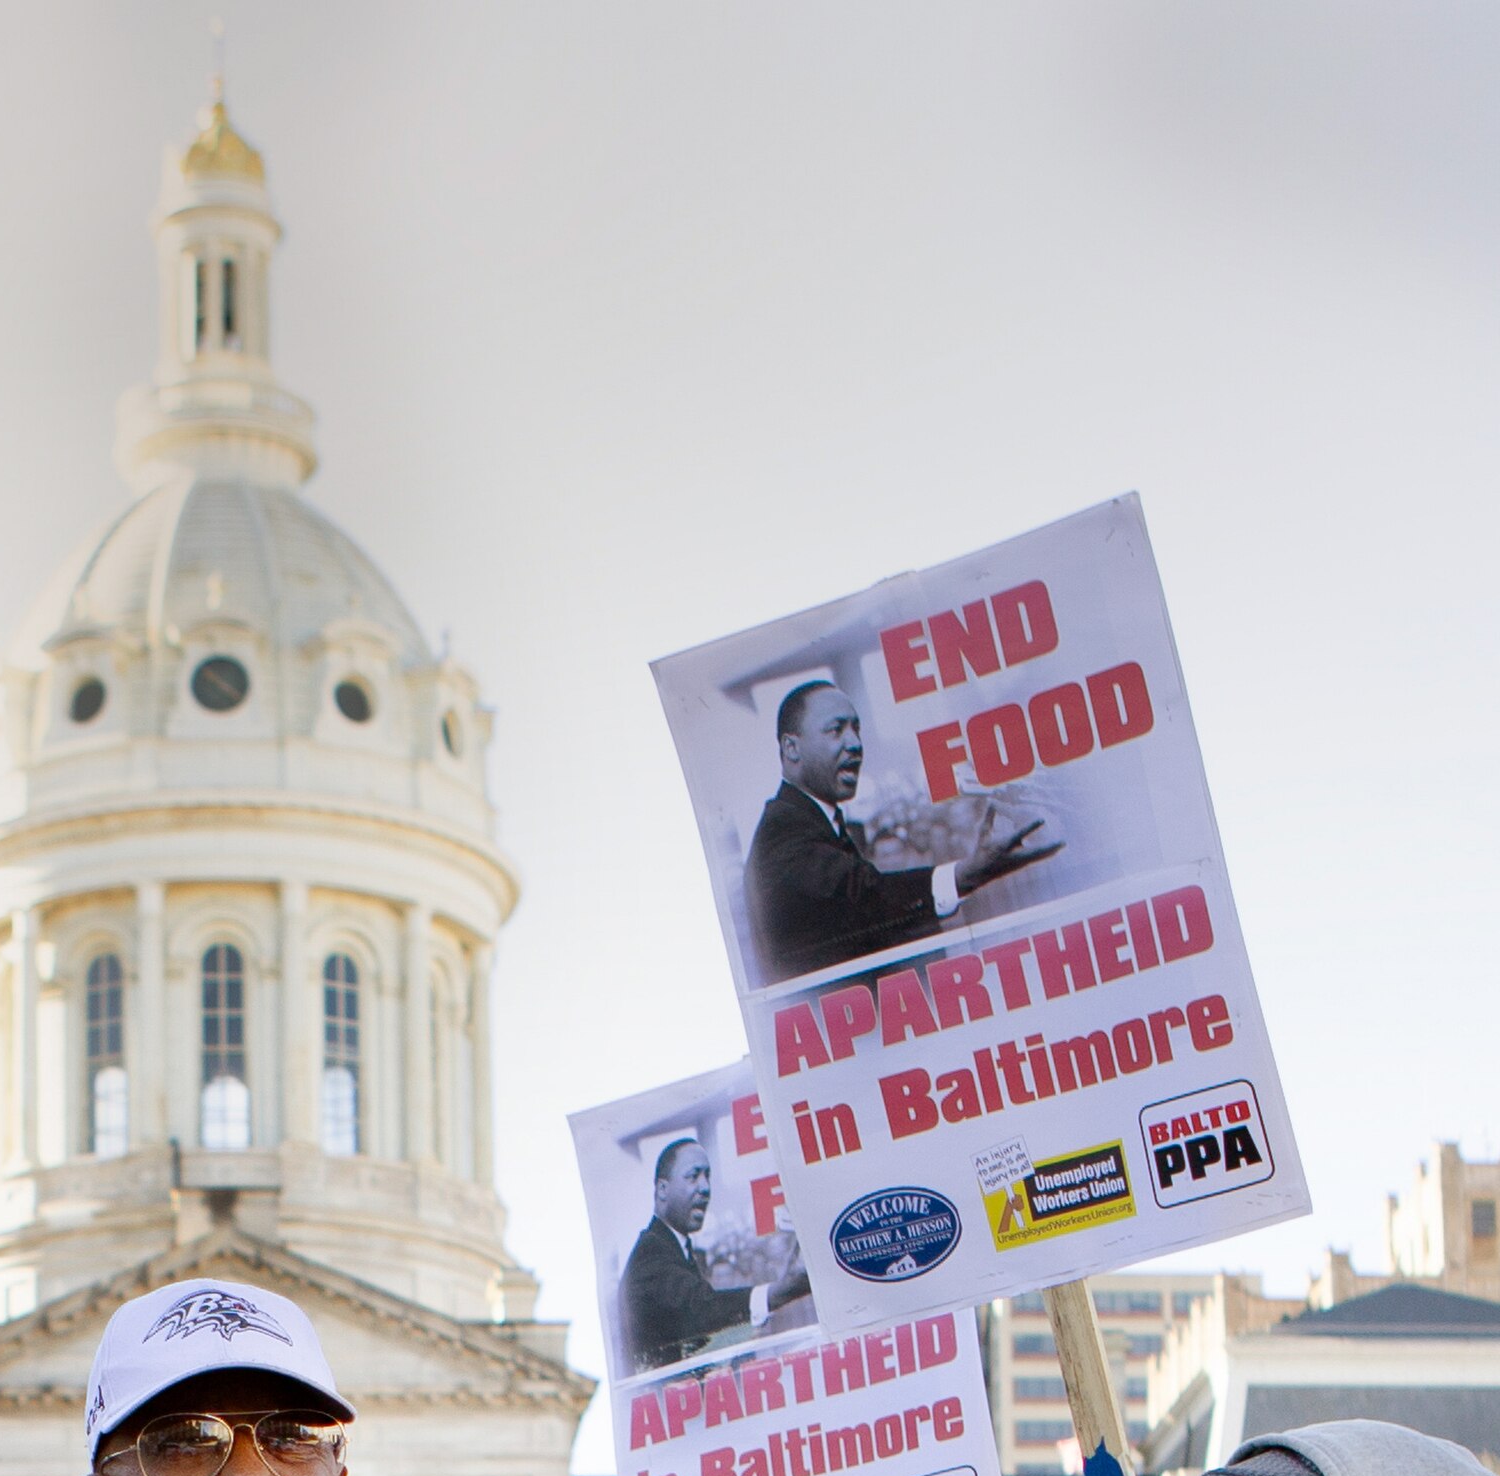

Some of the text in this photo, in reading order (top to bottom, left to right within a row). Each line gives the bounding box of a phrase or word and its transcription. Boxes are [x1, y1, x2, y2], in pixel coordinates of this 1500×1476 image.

[880, 580, 1060, 704] END
[916, 660, 1155, 805] FOOD
[774, 884, 1215, 1078] APARTHEID
[792, 1097, 861, 1167] in
[879, 994, 1234, 1142] Baltimore
[1148, 1100, 1251, 1146] BALTO
[1034, 1155, 1116, 1191] Unemployed
[1154, 1125, 1263, 1190] PPA
[846, 1195, 931, 1231] WELCOME
[1032, 1176, 1126, 1213] Workers Union
[840, 1230, 891, 1255] MATTHEW
[895, 1228, 905, 1241] A.
[906, 1216, 952, 1239] HENSON
[997, 1202, 1132, 1244] UnemployedWorkersUnion.org
[629, 1313, 958, 1451] APARTHEID
